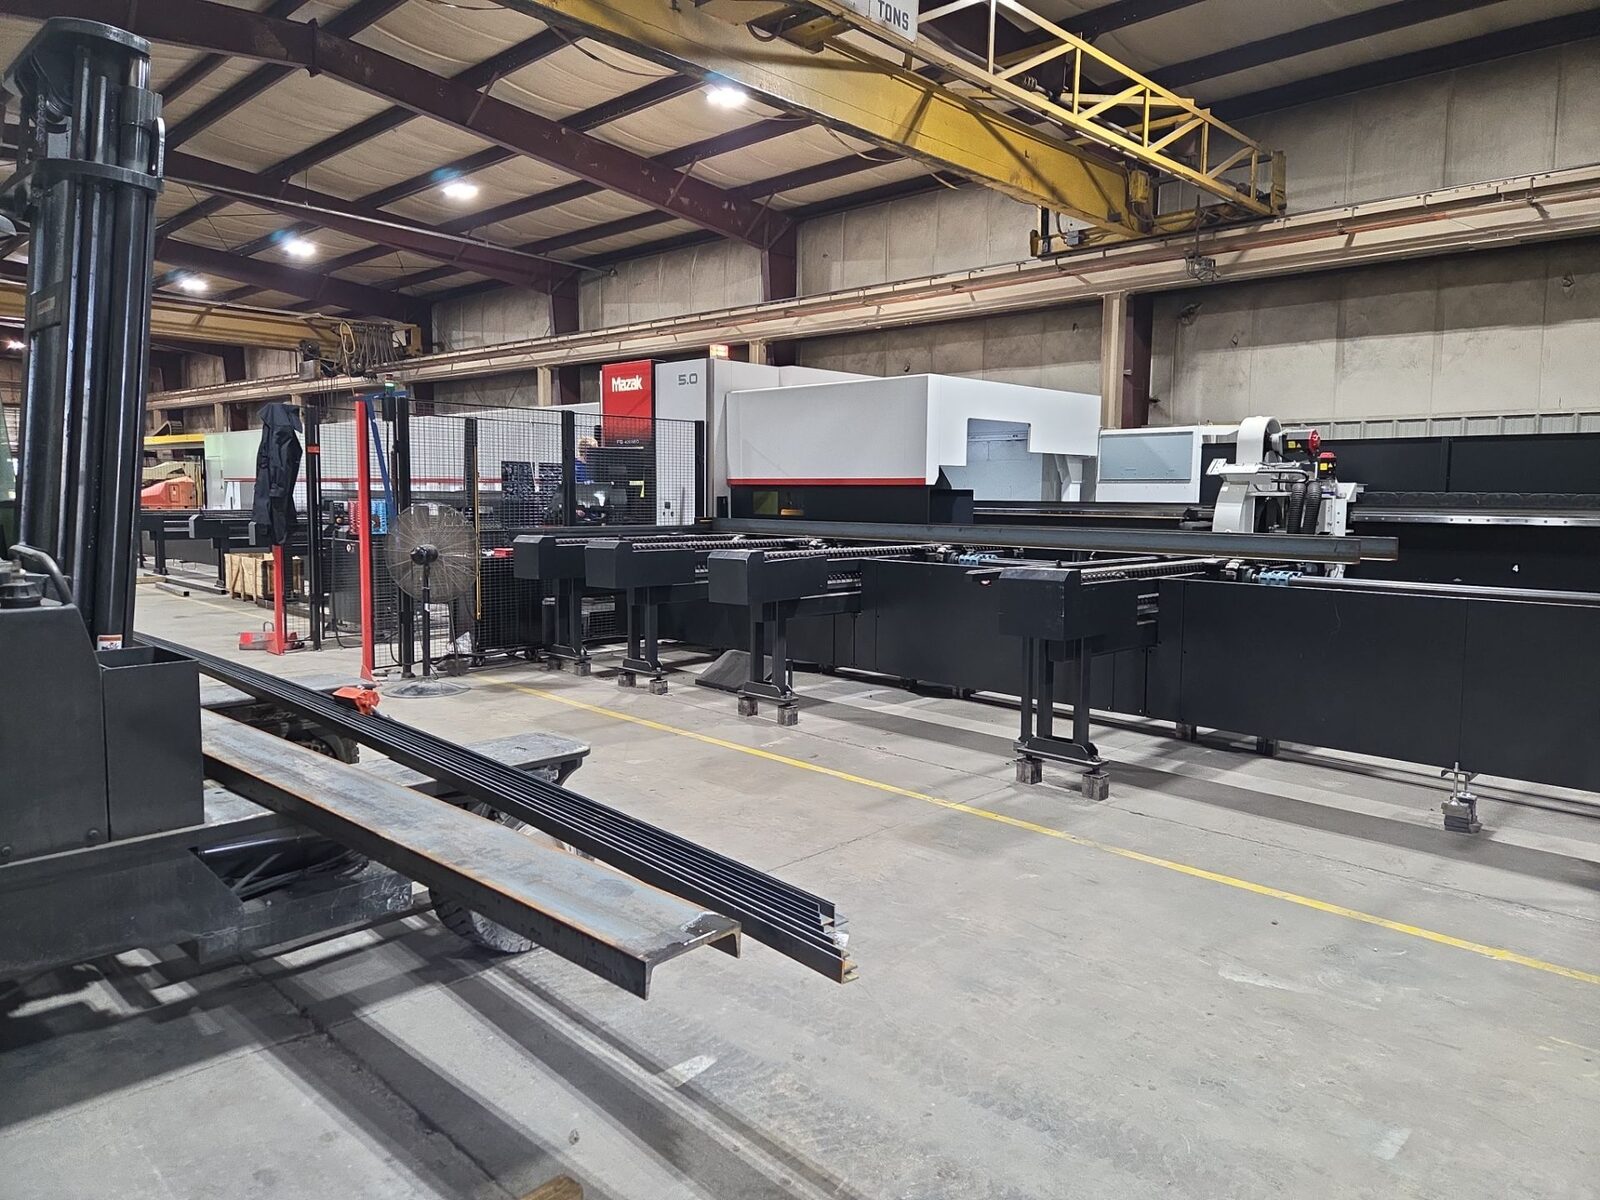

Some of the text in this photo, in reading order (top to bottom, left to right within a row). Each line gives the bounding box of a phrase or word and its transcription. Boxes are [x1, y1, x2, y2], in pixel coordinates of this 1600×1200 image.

[877, 0, 909, 31] TONS
[611, 375, 643, 392] Mazak
[678, 373, 698, 386] 5.0
